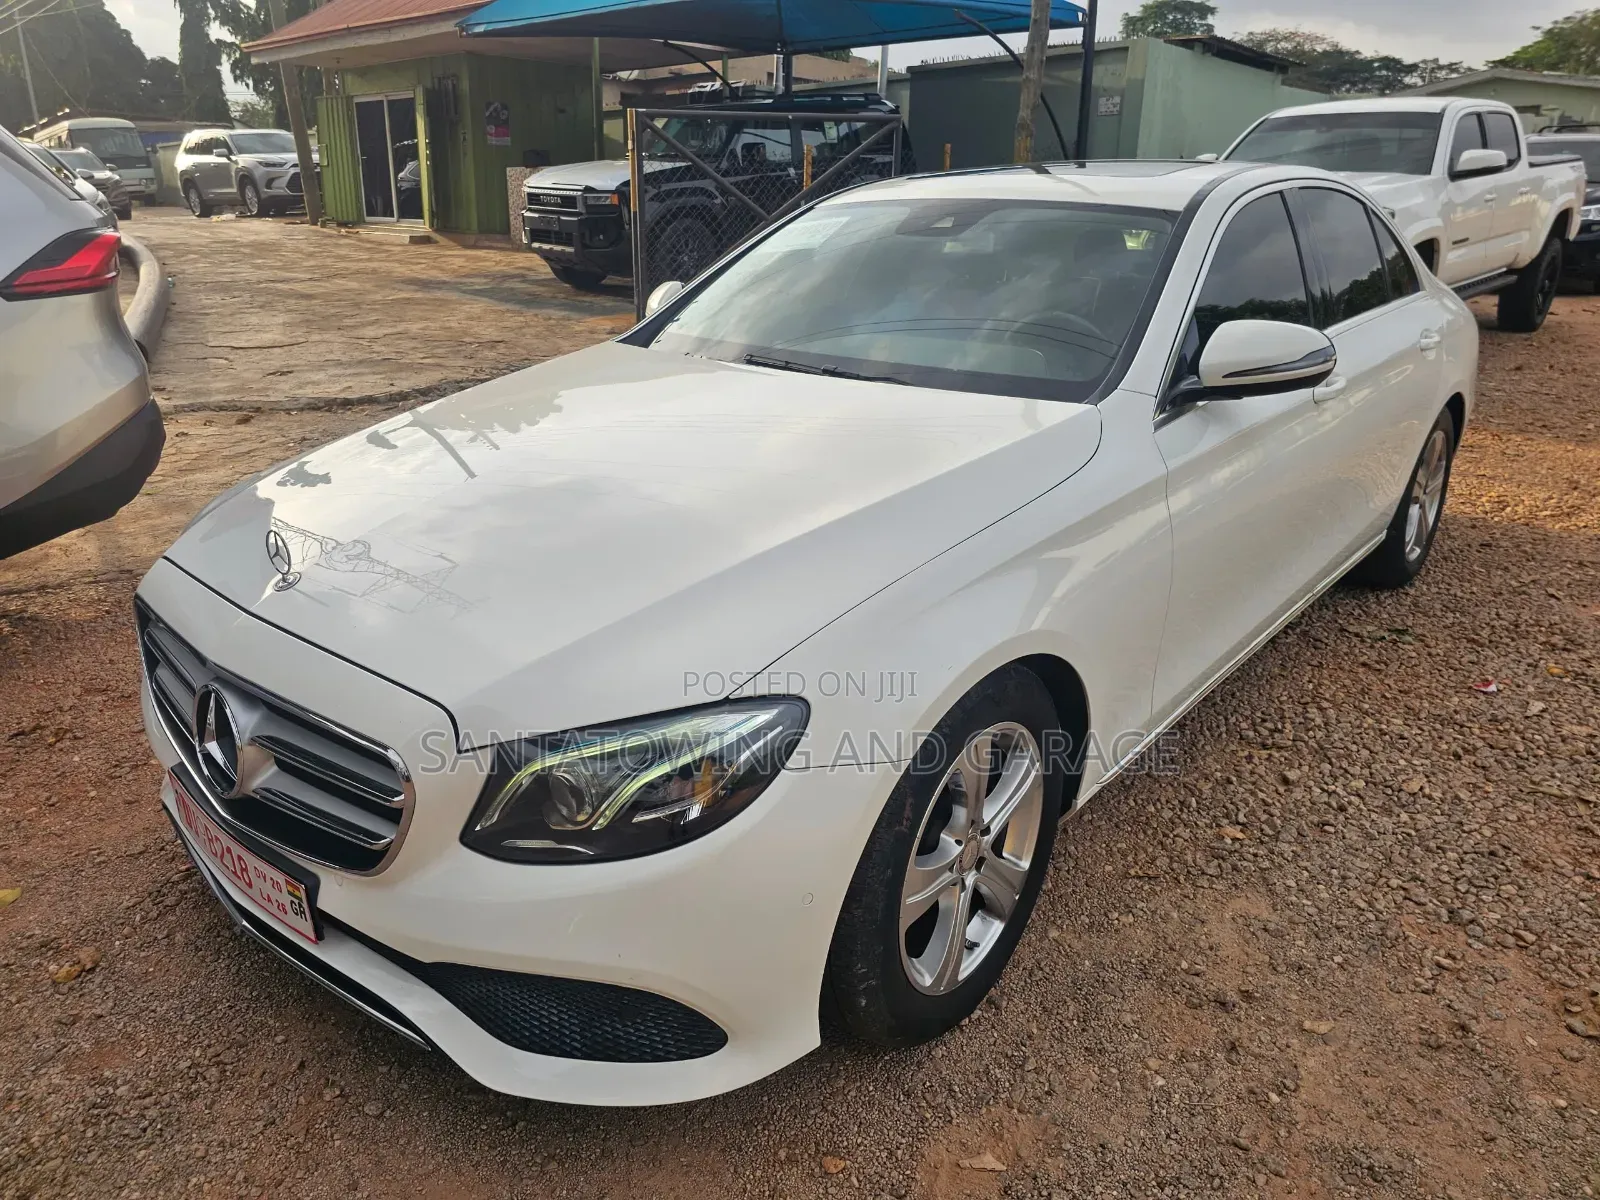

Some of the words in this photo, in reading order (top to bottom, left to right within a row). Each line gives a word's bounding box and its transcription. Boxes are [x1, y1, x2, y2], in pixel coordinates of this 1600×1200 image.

[540, 195, 562, 204] TOYOTA
[270, 876, 283, 894] 20
[259, 887, 274, 906] LA
[276, 898, 288, 916] 26
